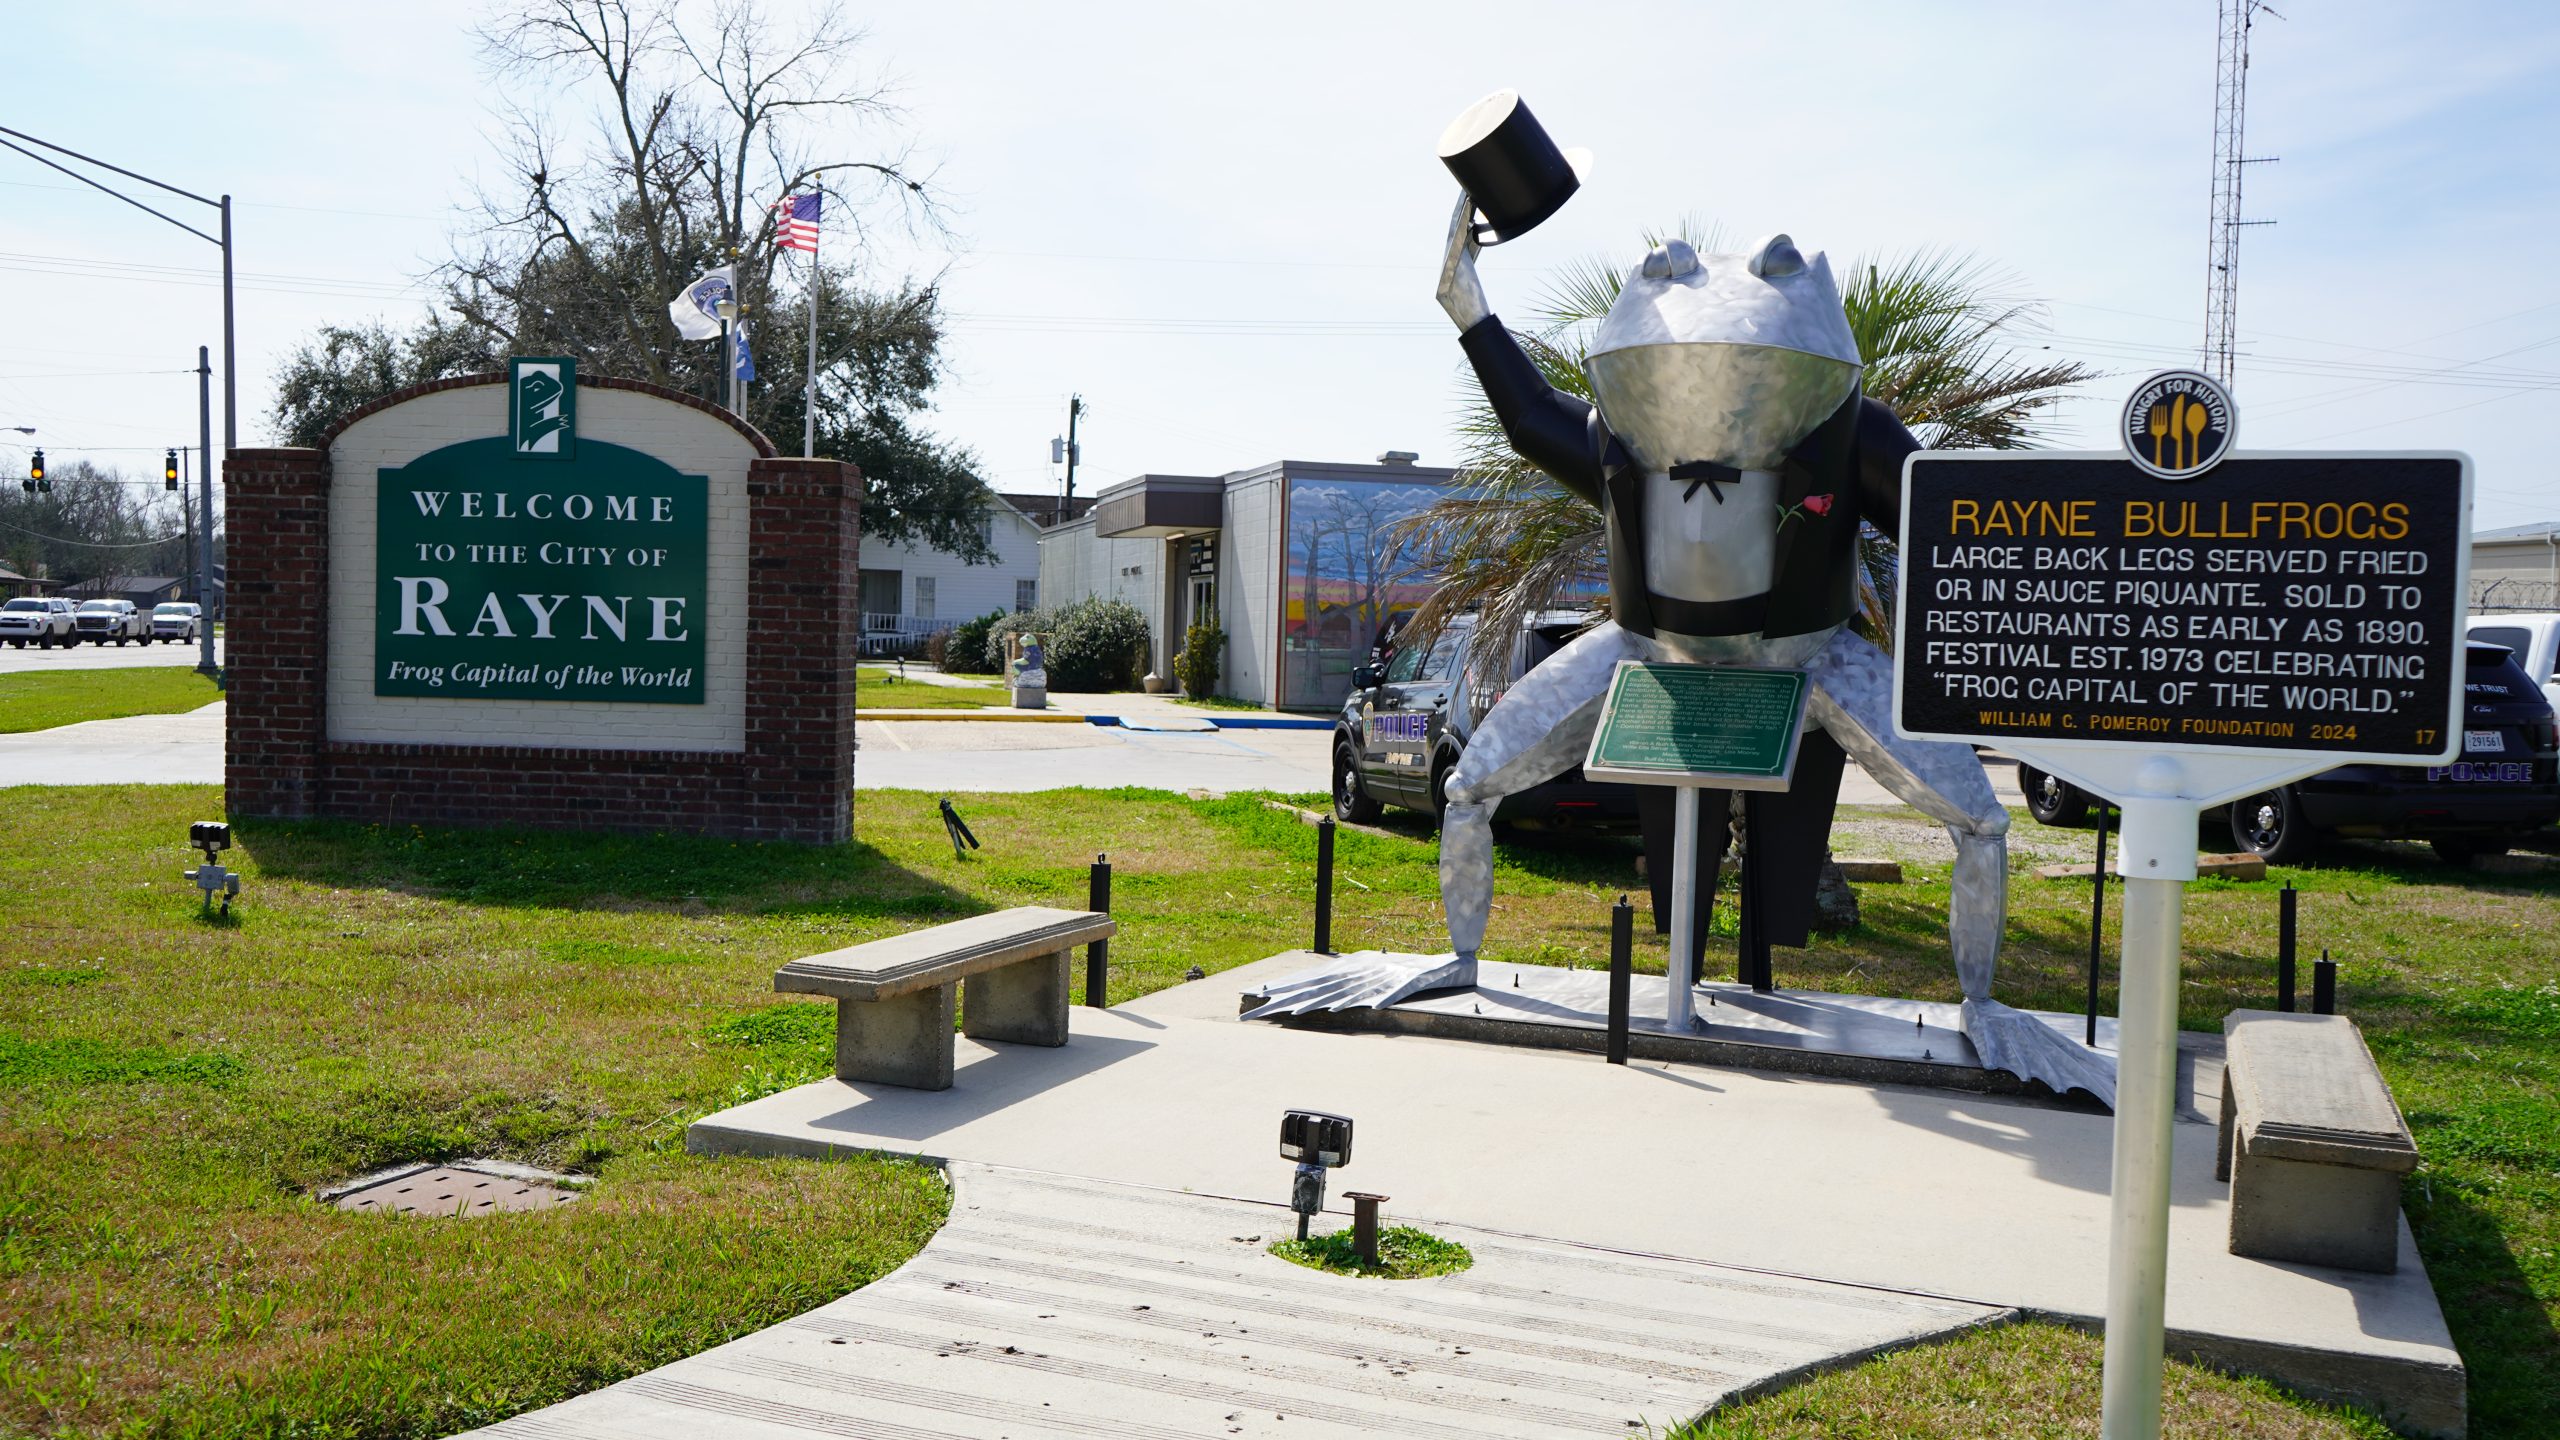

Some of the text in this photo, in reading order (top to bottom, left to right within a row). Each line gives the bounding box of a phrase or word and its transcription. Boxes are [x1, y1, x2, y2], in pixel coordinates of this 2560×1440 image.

[2130, 380, 2226, 435] HUNGRY FOR HISTORY
[411, 490, 673, 522] WELCOME
[1951, 499, 2409, 540] RAYNE BULLFROGS
[415, 541, 668, 567] TO THE CITY OF
[1932, 545, 2428, 575] LARGE BACK LEGS SERVED FRIED
[392, 576, 688, 642] RAYNE
[1935, 578, 2422, 610] OR IN SAUCE PIQUANTE. SOLD TO
[1926, 610, 2430, 645] RESTAURANTS AS EARLY AS 1890.
[388, 661, 692, 690] Frog Capital of the World
[1926, 641, 2425, 680] FESTIVAL EST. 1973 CELEBRATING
[2027, 677, 2148, 704] CAPITAL
[2158, 681, 2198, 706] OF
[2208, 682, 2270, 708] THE
[2481, 684, 2508, 694] TRUST
[1374, 713, 1428, 742] POLICE
[1979, 711, 2358, 740] WILLIAM C. POMEROY FOUNDATION 2024
[2416, 729, 2436, 745] 17
[2472, 736, 2501, 746] 291561
[2427, 762, 2533, 782] POLICE
